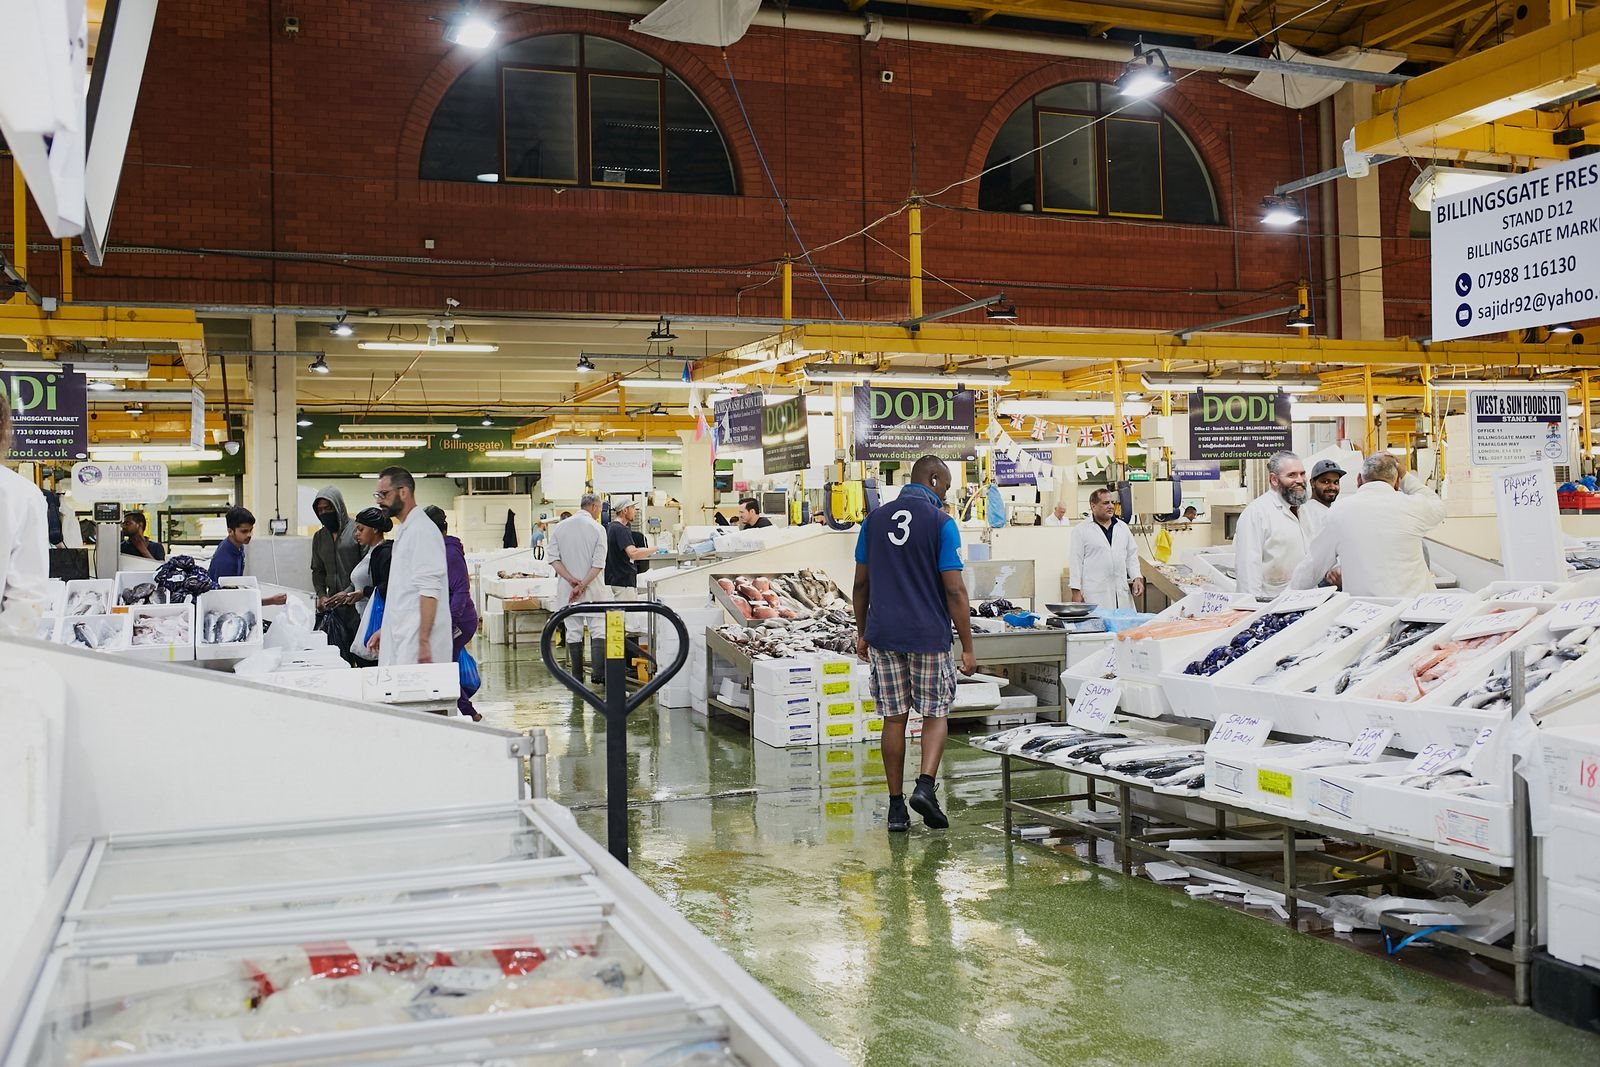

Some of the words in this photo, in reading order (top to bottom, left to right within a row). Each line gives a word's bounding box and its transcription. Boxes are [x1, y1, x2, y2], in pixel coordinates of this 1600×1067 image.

[1437, 177, 1550, 223] BILLINGSGATE
[1502, 208, 1544, 230] STAND
[1548, 200, 1573, 219] D12
[1467, 228, 1552, 260] BILLINGSGATE
[1556, 217, 1600, 240] MARK
[1478, 267, 1519, 289] 07988
[1523, 255, 1576, 281] 116130
[1478, 287, 1600, 321] sajidr92@yahoo.
[0, 374, 57, 411] Di
[870, 391, 954, 421] DODi
[1476, 395, 1498, 415] WEST
[1500, 398, 1506, 415] &
[1506, 395, 1522, 415] SUN
[1523, 395, 1548, 415] FOODS
[1549, 395, 1561, 415] LTD
[1203, 394, 1275, 422] DODi
[439, 439, 505, 452] (Billingsgate)
[887, 509, 913, 546] 3
[1085, 683, 1114, 697] SALMON
[1212, 724, 1233, 741] £10
[1226, 713, 1259, 726] SALMON
